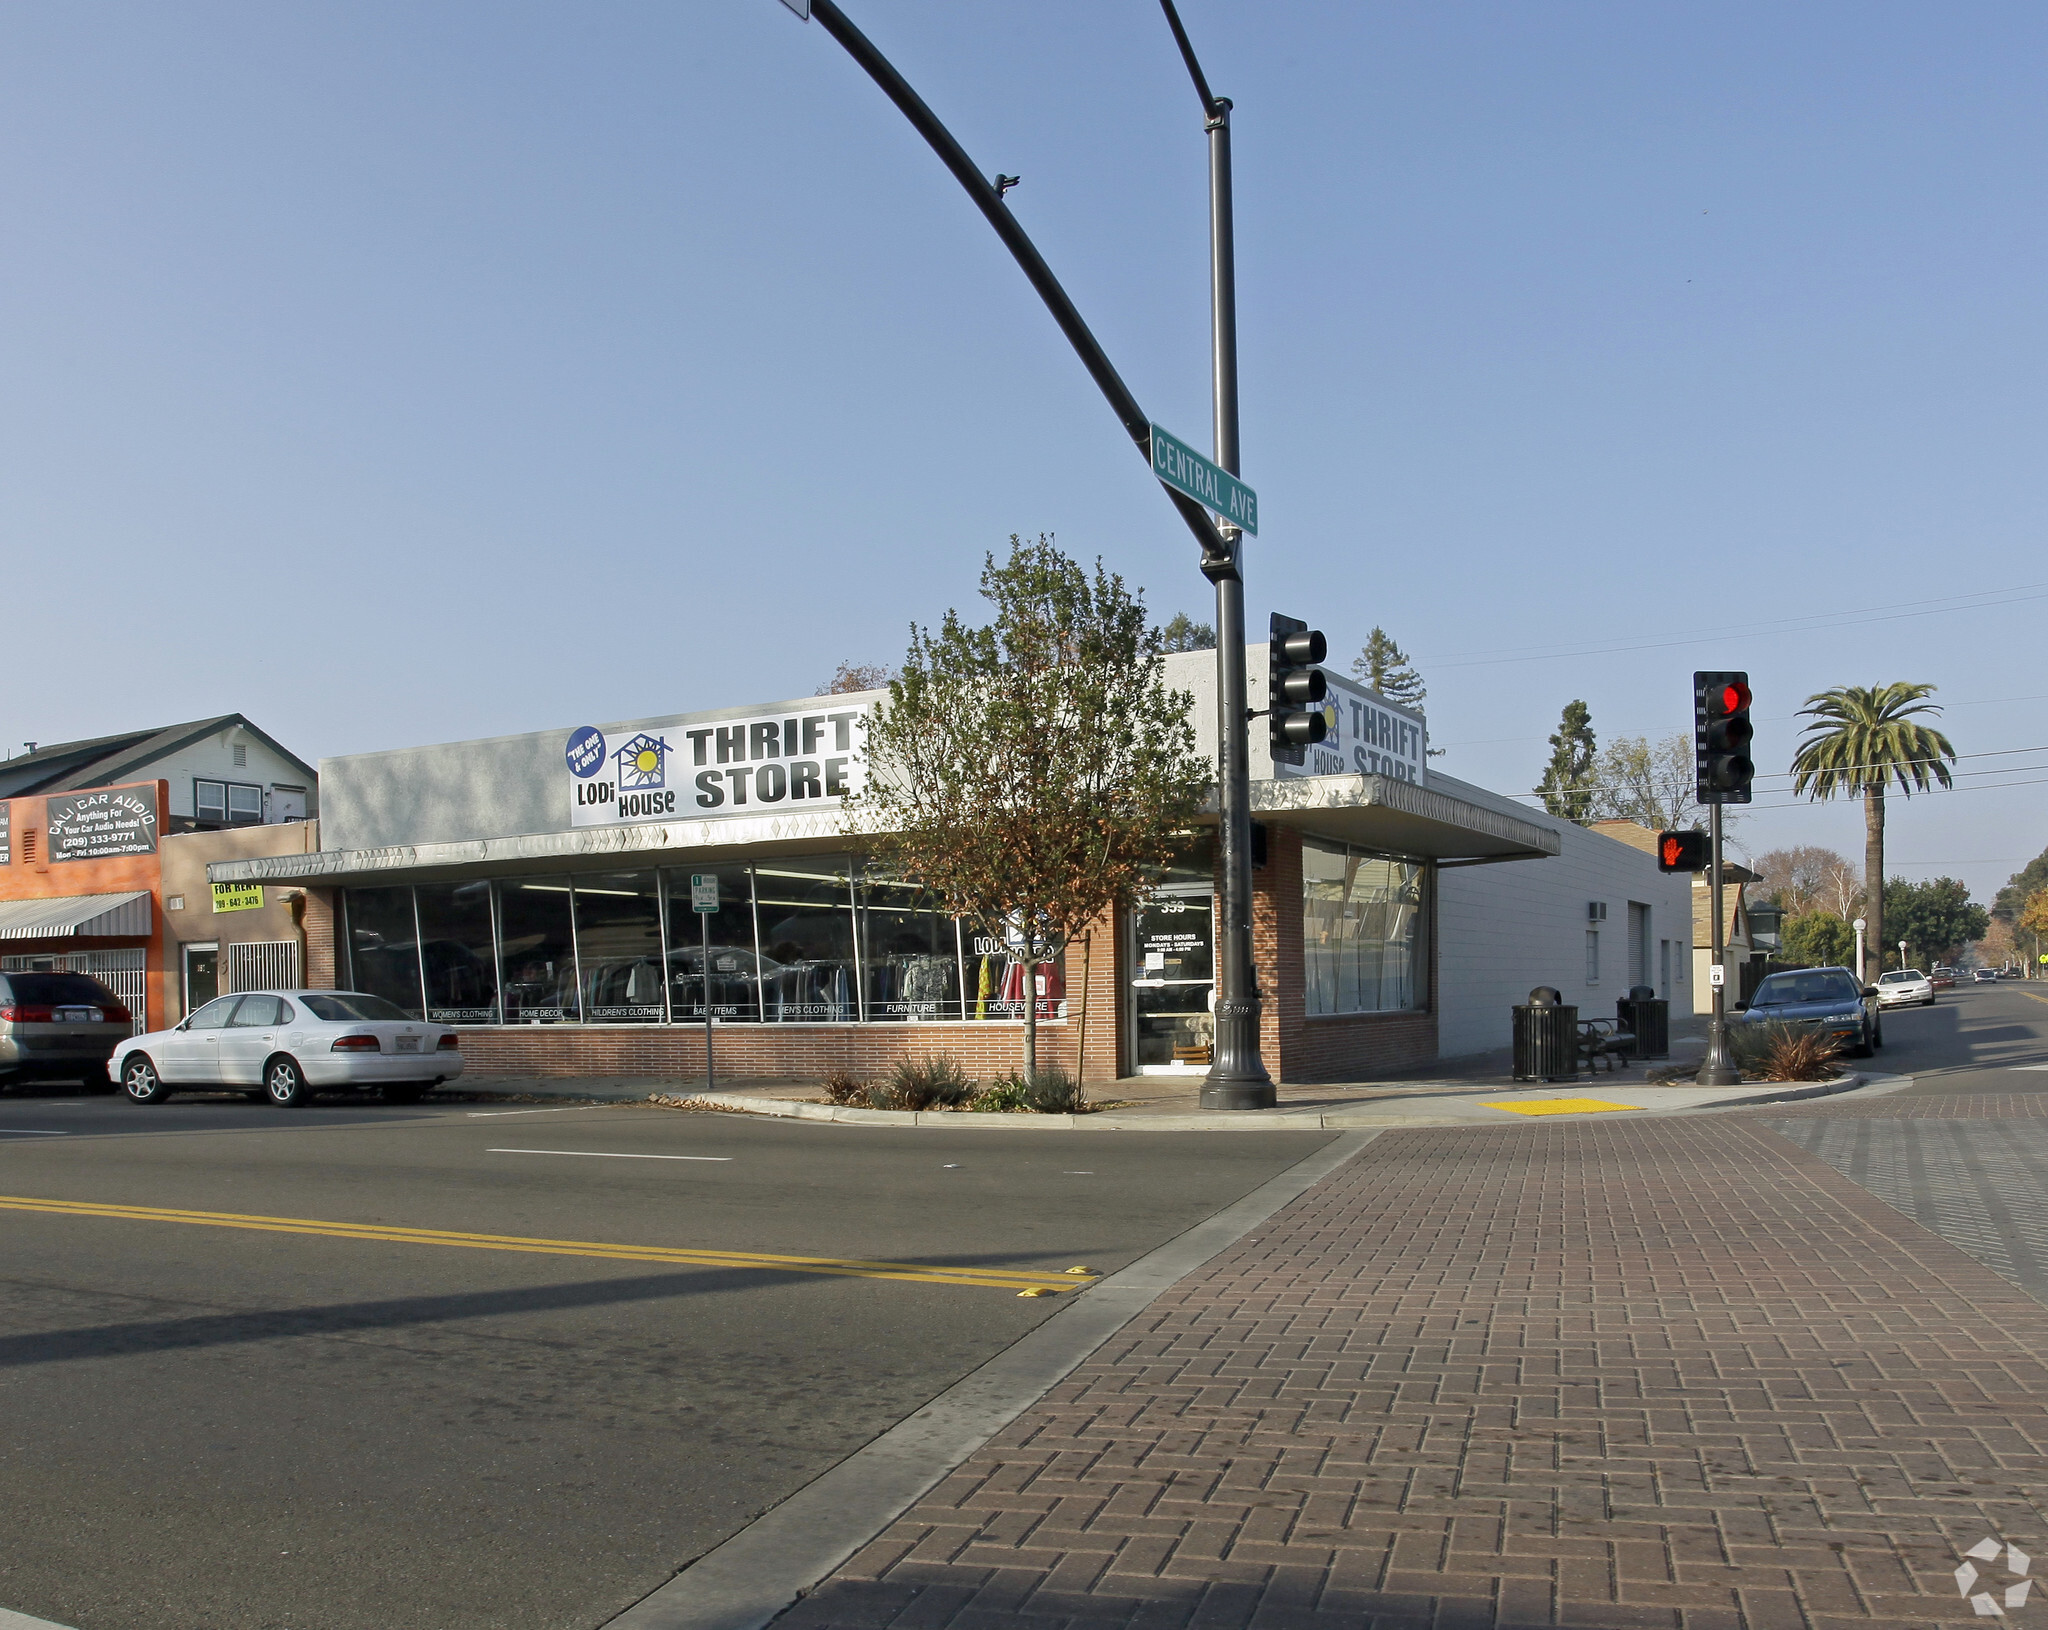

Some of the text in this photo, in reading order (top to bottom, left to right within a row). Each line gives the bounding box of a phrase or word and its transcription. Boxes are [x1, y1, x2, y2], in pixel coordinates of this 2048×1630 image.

[1156, 436, 1255, 527] CENTRAL AVE
[1349, 698, 1419, 761] THRIFT
[584, 732, 600, 749] ONE
[686, 711, 858, 767] THRIFT
[574, 762, 582, 773] &
[695, 757, 851, 808] STORE
[49, 794, 156, 836] CALI CAR AUDIO
[76, 808, 123, 823] Anything For
[64, 818, 140, 835] Your Car Audio Needs!
[63, 831, 135, 849] (209) 333-9771
[56, 851, 71, 860] Mon
[76, 849, 87, 858] Fri
[214, 884, 232, 895] FOR
[1160, 901, 1185, 914] 359
[629, 1007, 665, 1016] CLOTHING
[714, 1006, 738, 1015] ITEMS
[778, 1005, 844, 1014] MEN'S CLOTHING
[886, 1004, 936, 1013] FURNITURE
[989, 1002, 1048, 1012] HOUSEWRE
[432, 1009, 493, 1019] WOMEN'S CLOTHING
[519, 1009, 564, 1018] HOME DECOR
